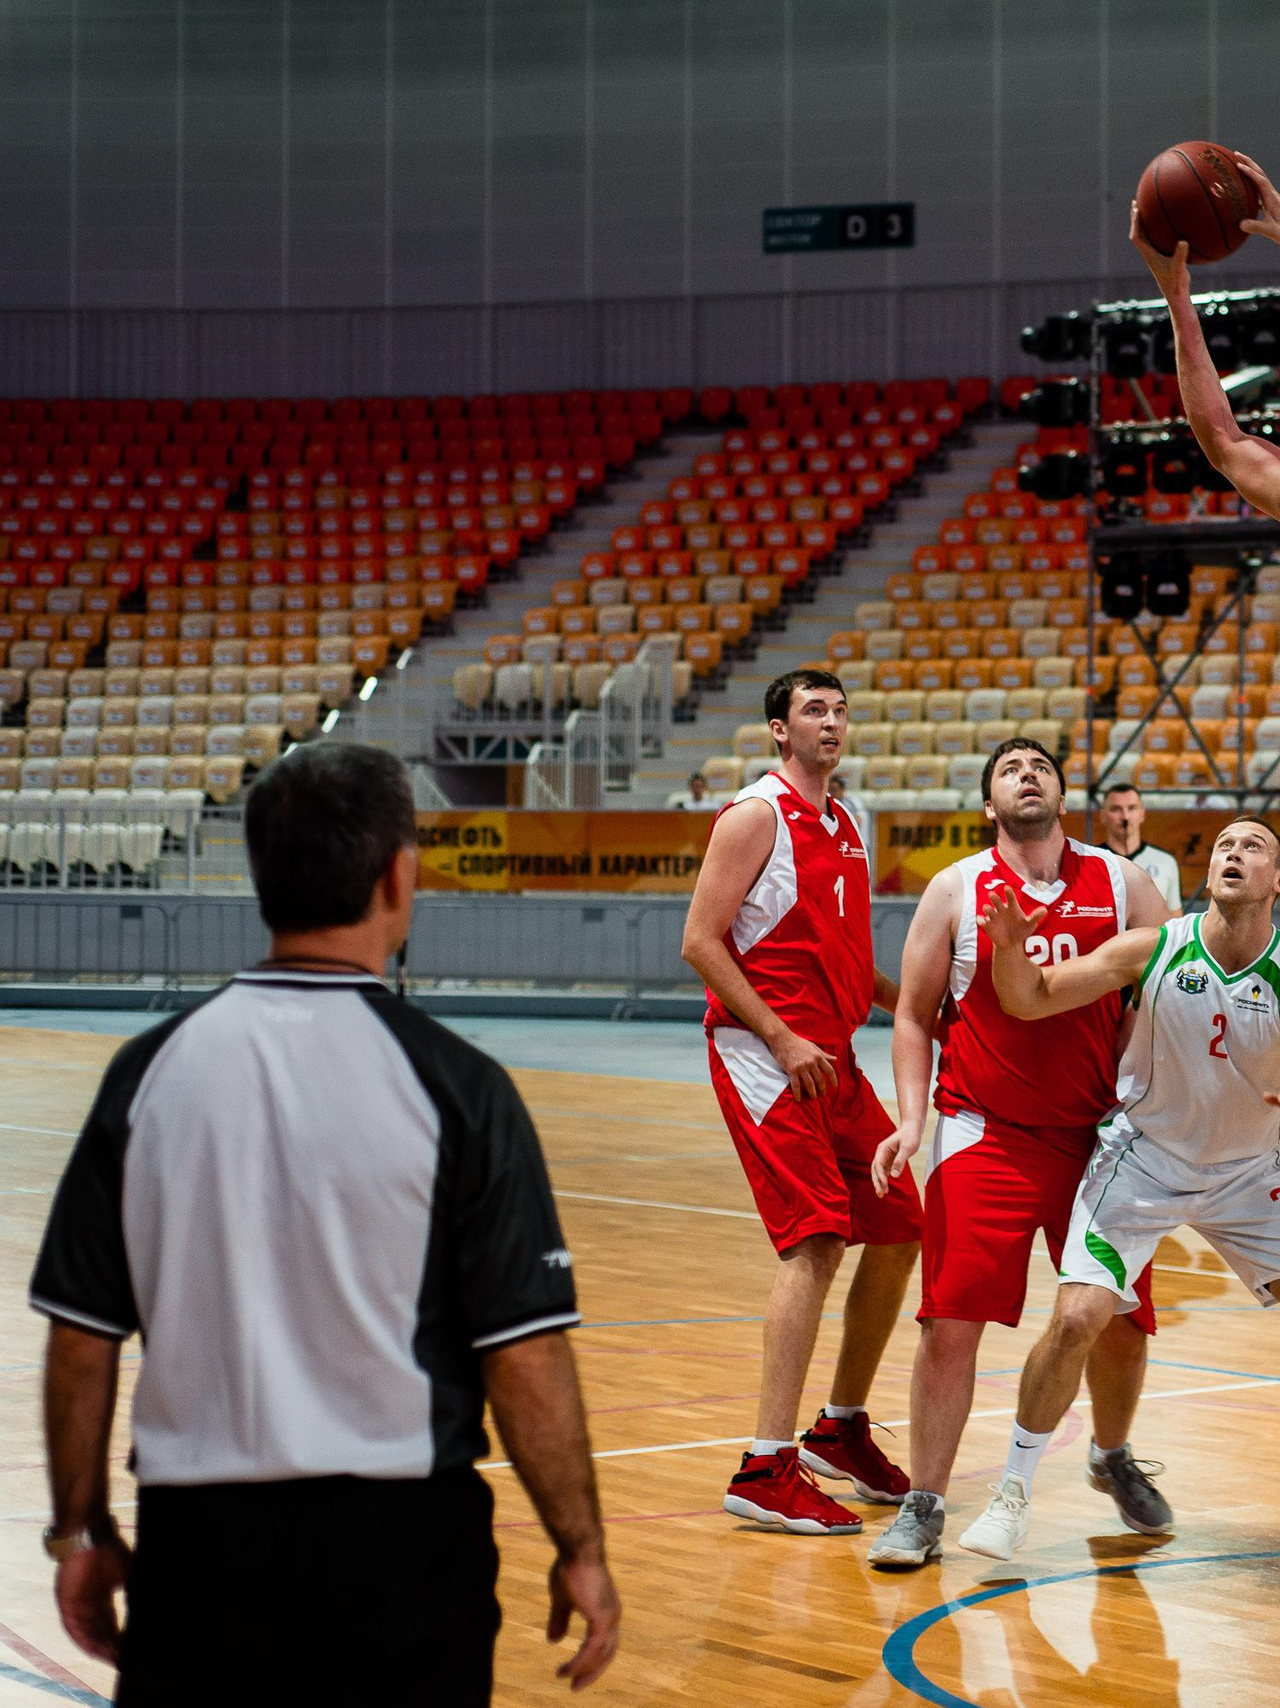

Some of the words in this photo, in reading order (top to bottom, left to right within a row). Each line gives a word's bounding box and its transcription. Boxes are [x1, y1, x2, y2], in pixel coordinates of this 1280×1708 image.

[846, 214, 867, 241] D
[886, 212, 903, 239] 3
[417, 826, 502, 848] ОСНЕФТЬ
[459, 849, 590, 876] СПОРТИВНЫЙ
[833, 875, 845, 917] 1
[1025, 933, 1079, 966] 20
[1208, 1013, 1228, 1060] 2
